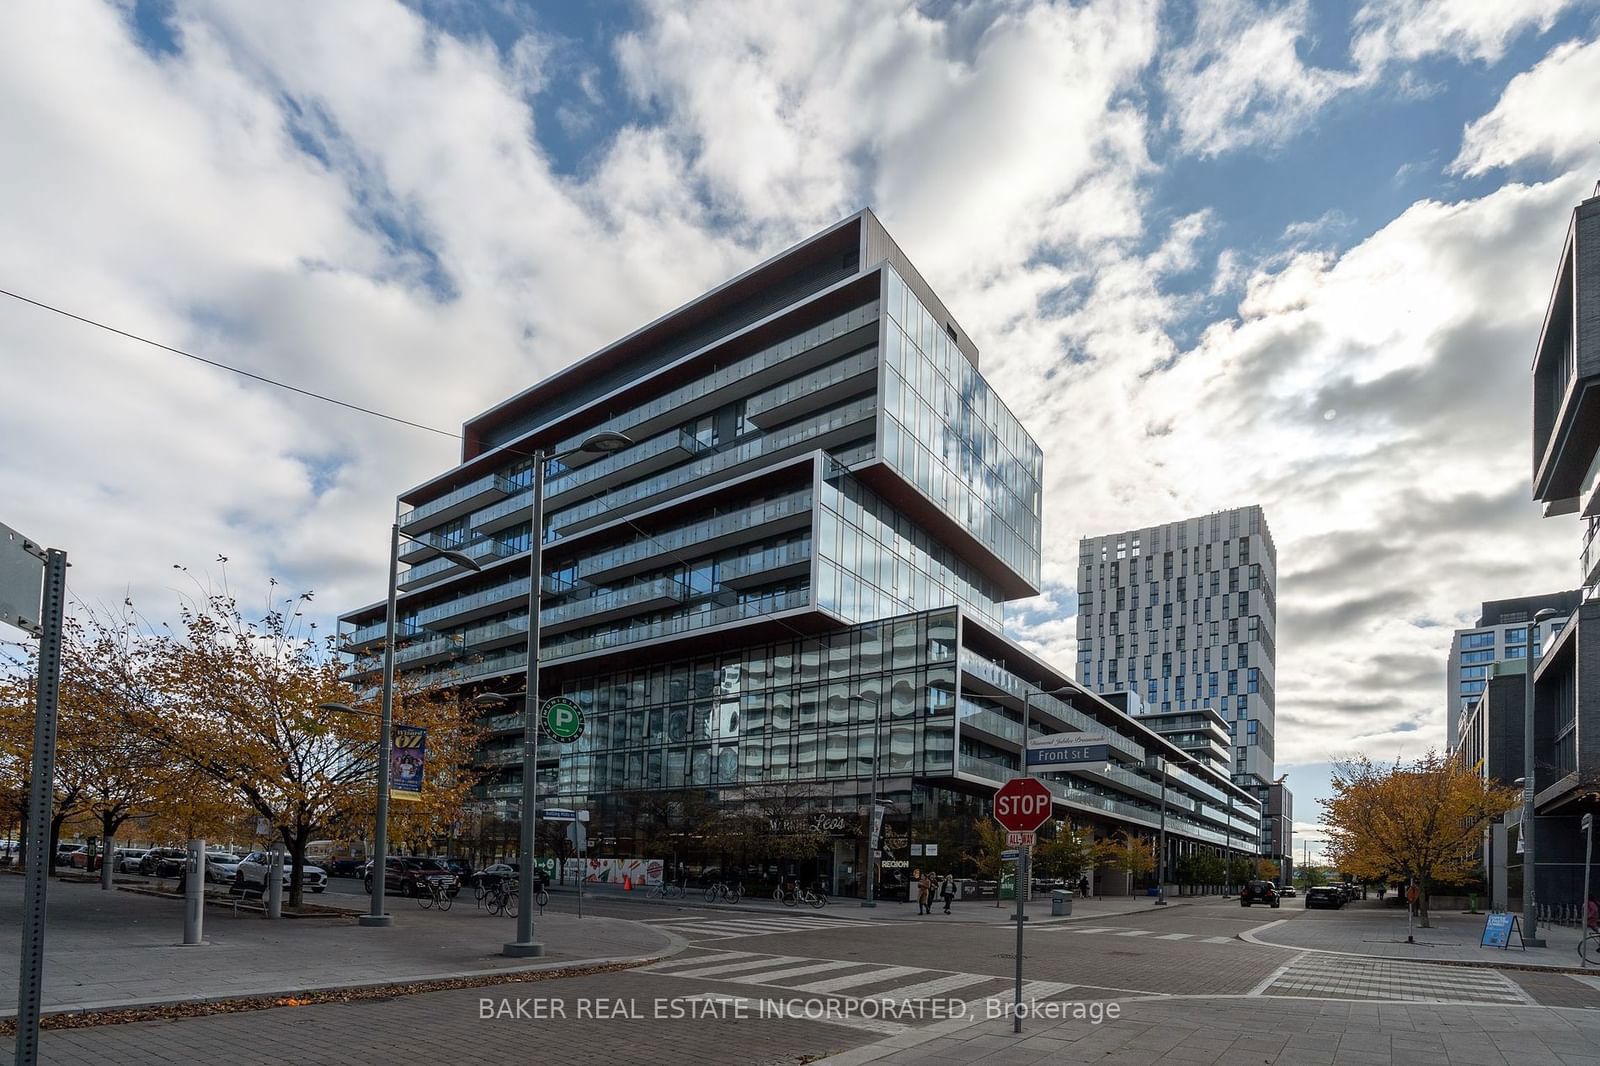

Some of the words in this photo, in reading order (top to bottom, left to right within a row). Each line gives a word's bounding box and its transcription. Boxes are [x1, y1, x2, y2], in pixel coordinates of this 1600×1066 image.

[542, 698, 584, 722] MUNICIPAL
[556, 709, 573, 727] P
[542, 721, 583, 742] PARKING
[1038, 750, 1068, 761] Front
[1072, 750, 1081, 759] St
[1083, 747, 1090, 759] E
[998, 794, 1048, 815] STOP
[809, 813, 845, 833] Leo's
[1010, 834, 1034, 845] ALL-WAY
